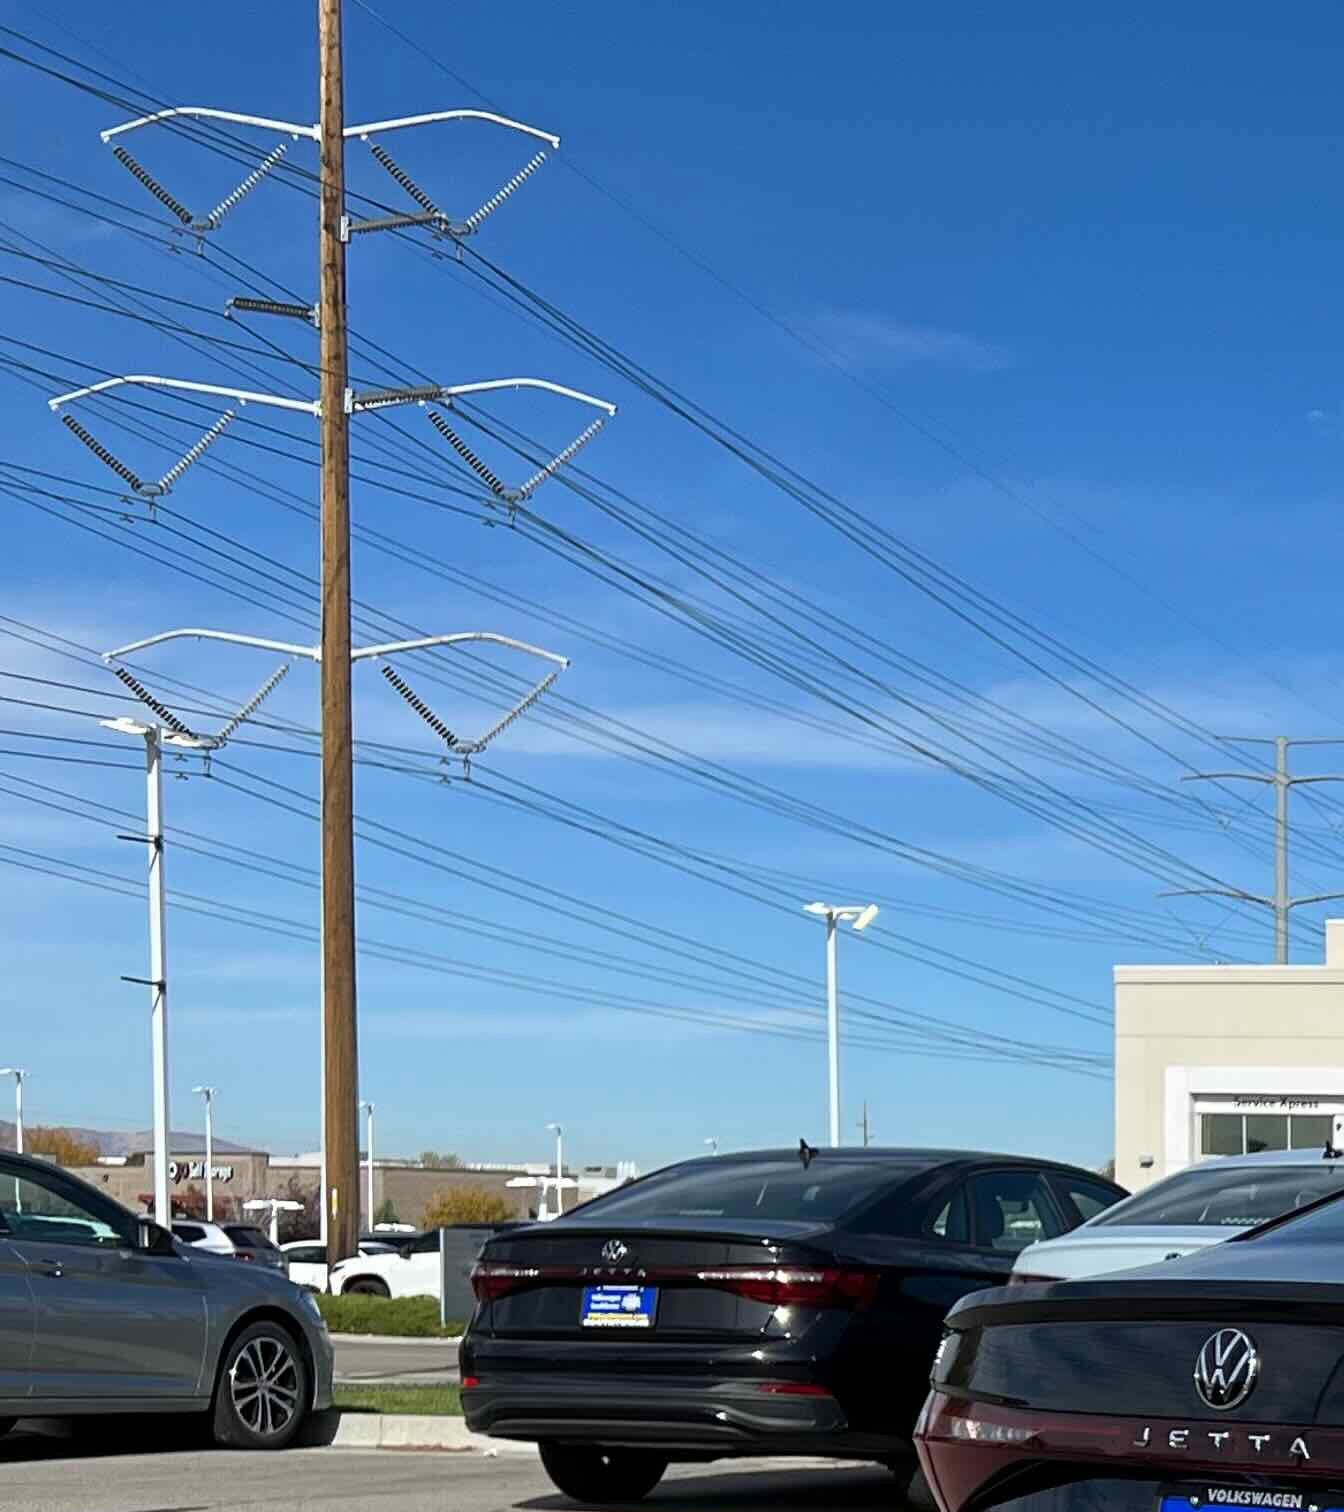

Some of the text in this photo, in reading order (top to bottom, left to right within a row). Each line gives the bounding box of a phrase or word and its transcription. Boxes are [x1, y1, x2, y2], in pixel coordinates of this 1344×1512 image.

[1232, 1096, 1276, 1109] Service
[1196, 1329, 1255, 1409] VW
[1133, 1427, 1311, 1459] JETTA
[1208, 1488, 1303, 1508] VOLKSWAGEN
